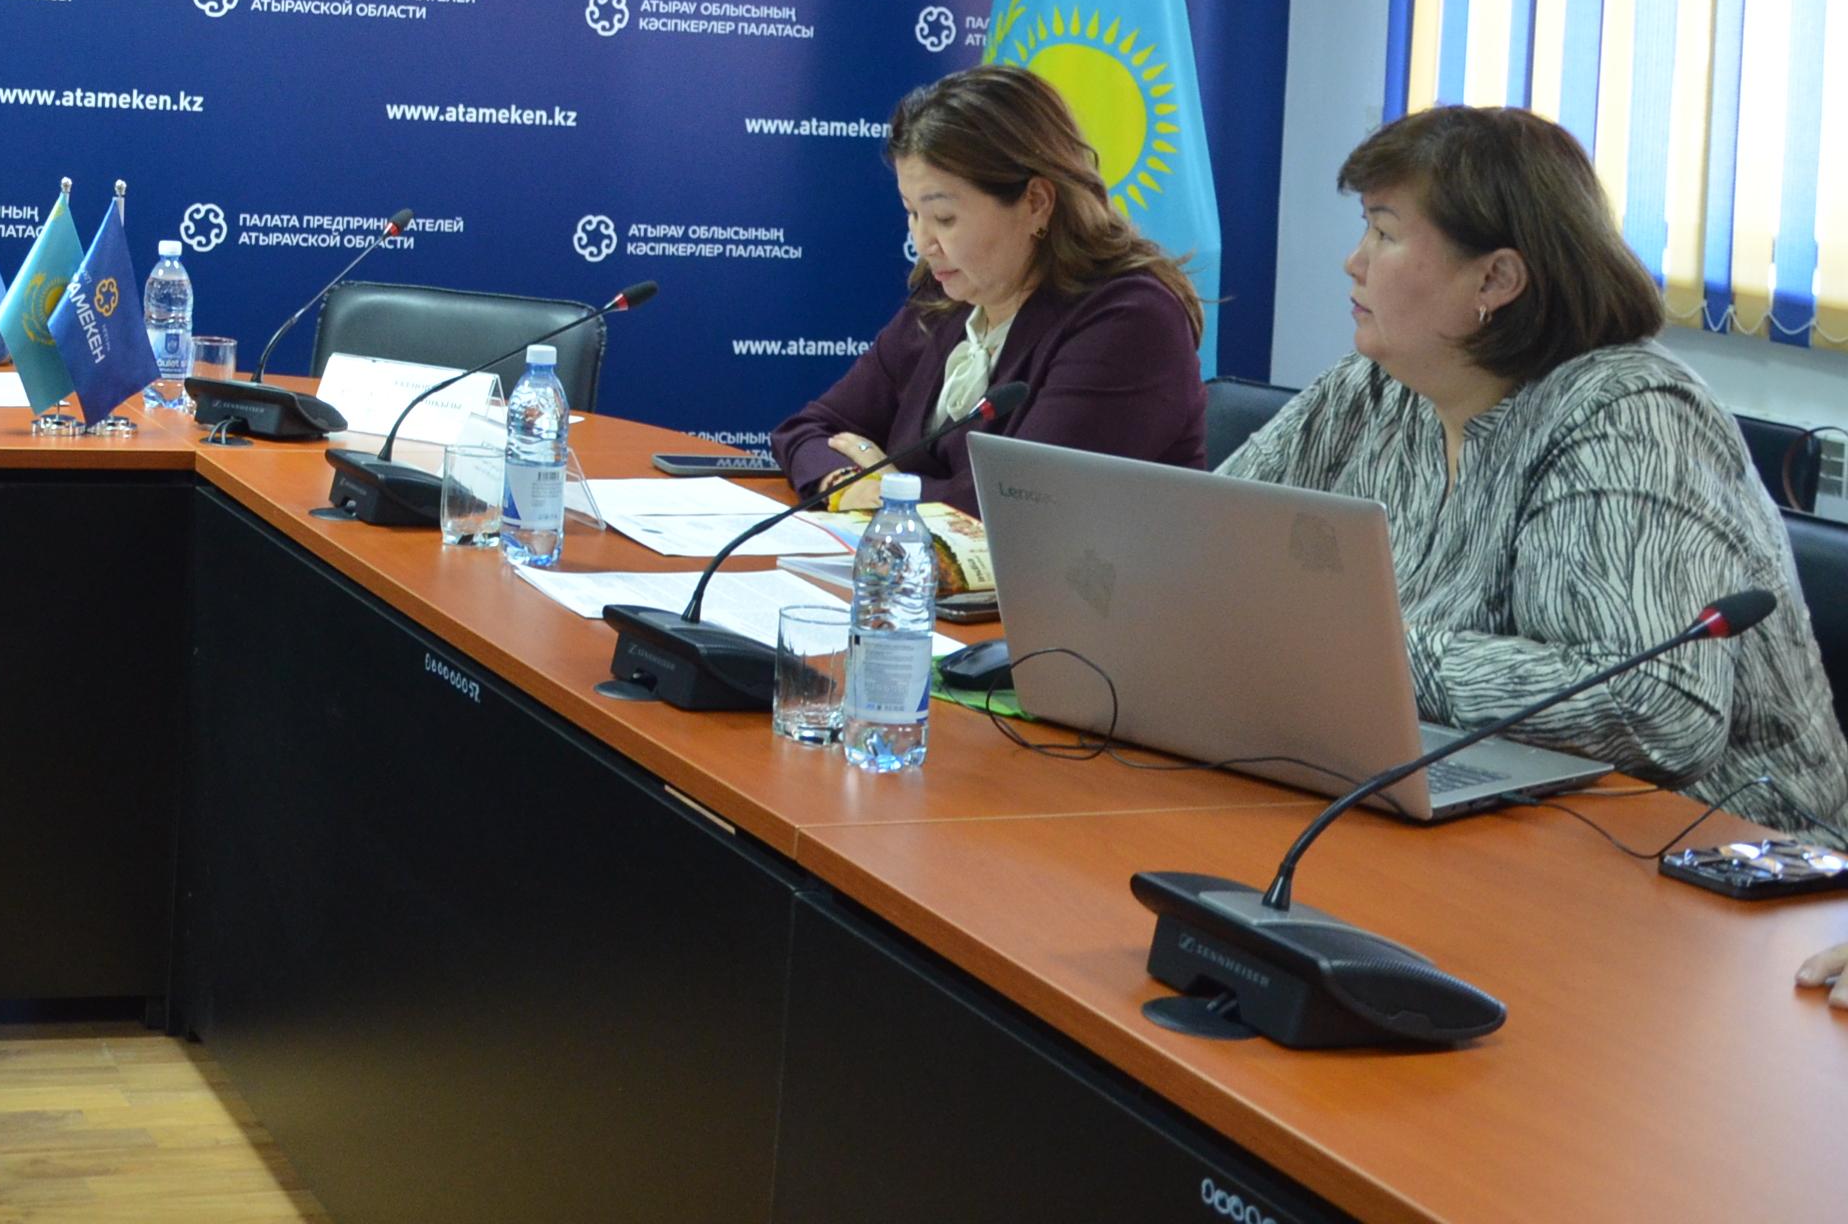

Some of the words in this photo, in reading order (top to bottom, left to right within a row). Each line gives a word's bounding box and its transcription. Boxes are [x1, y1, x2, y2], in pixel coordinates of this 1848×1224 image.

[355, 3, 427, 19] ОБЛАСТИ
[640, 0, 697, 14] АТЫРАУ
[700, 2, 797, 22] ОБЛЫСЫНЫҢ
[638, 17, 735, 34] КӘСІПКЕРЛЕР
[738, 22, 814, 38] ПАЛАТАСЫ
[385, 100, 578, 128] www.atameken.kz
[744, 117, 894, 139] www.atameken
[239, 213, 300, 229] ПАЛАТА
[303, 215, 464, 233] ПРЕДПРИНАТЕЛЕЙ
[628, 223, 685, 238] АТЫРАУ
[688, 225, 785, 243] ОБЛЫСЫНЫҢ
[238, 231, 340, 248] АТЫРАУСКОЙ
[344, 234, 415, 250] ОБЛАСТИ
[626, 242, 723, 257] КӘСІПКЕРЛЕР
[725, 244, 802, 259] ПАЛАТАСЫ
[67, 282, 105, 364] АМЕКЕН
[732, 337, 875, 356] www.atameke
